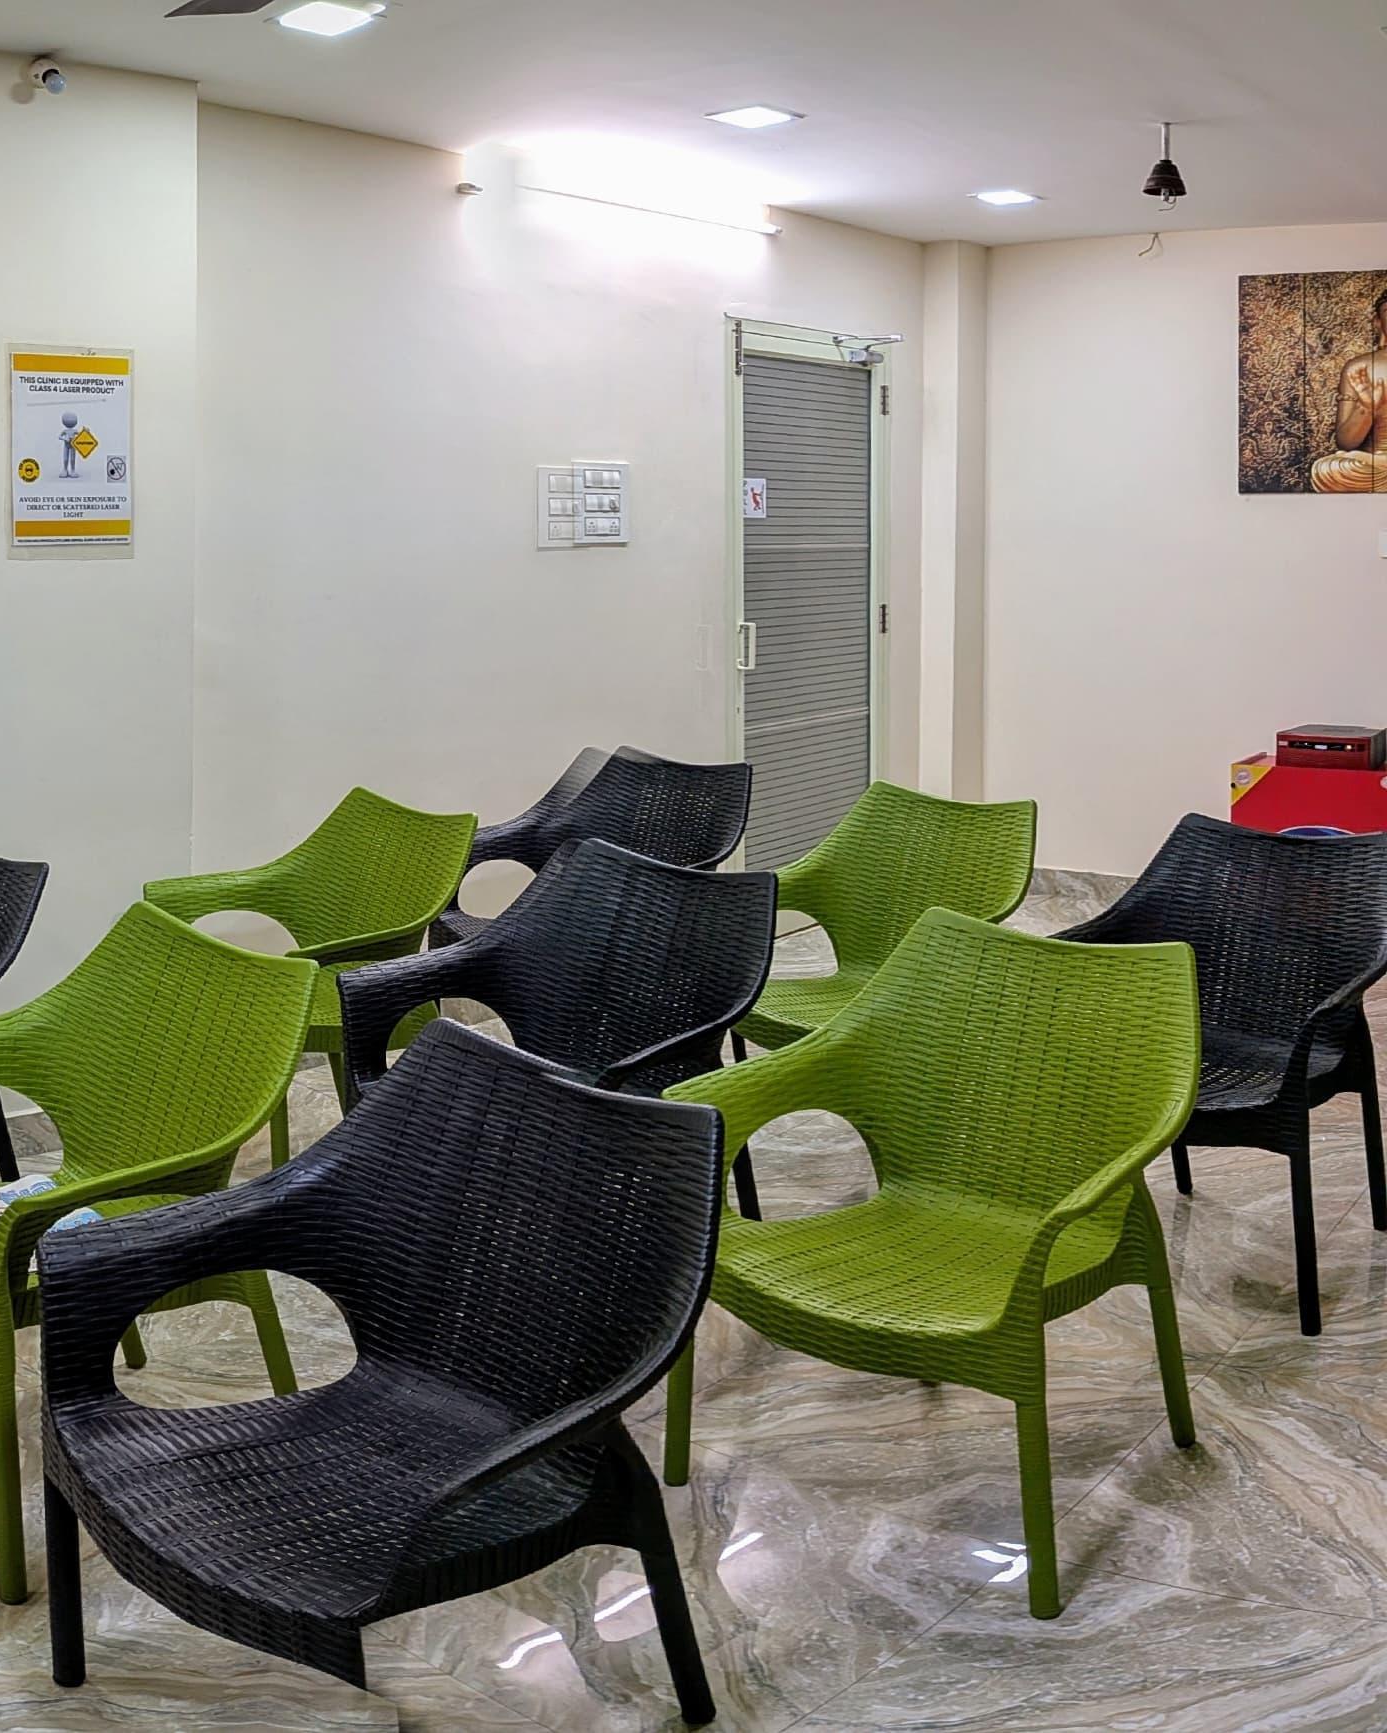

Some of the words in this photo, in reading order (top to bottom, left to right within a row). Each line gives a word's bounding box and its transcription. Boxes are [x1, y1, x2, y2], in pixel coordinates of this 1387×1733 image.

[19, 376, 36, 384] THIS
[37, 377, 61, 385] CLINIC
[70, 378, 104, 387] EQUIPPED
[105, 379, 124, 387] WITH
[59, 386, 80, 394] LASER
[81, 386, 115, 395] PRODUCT
